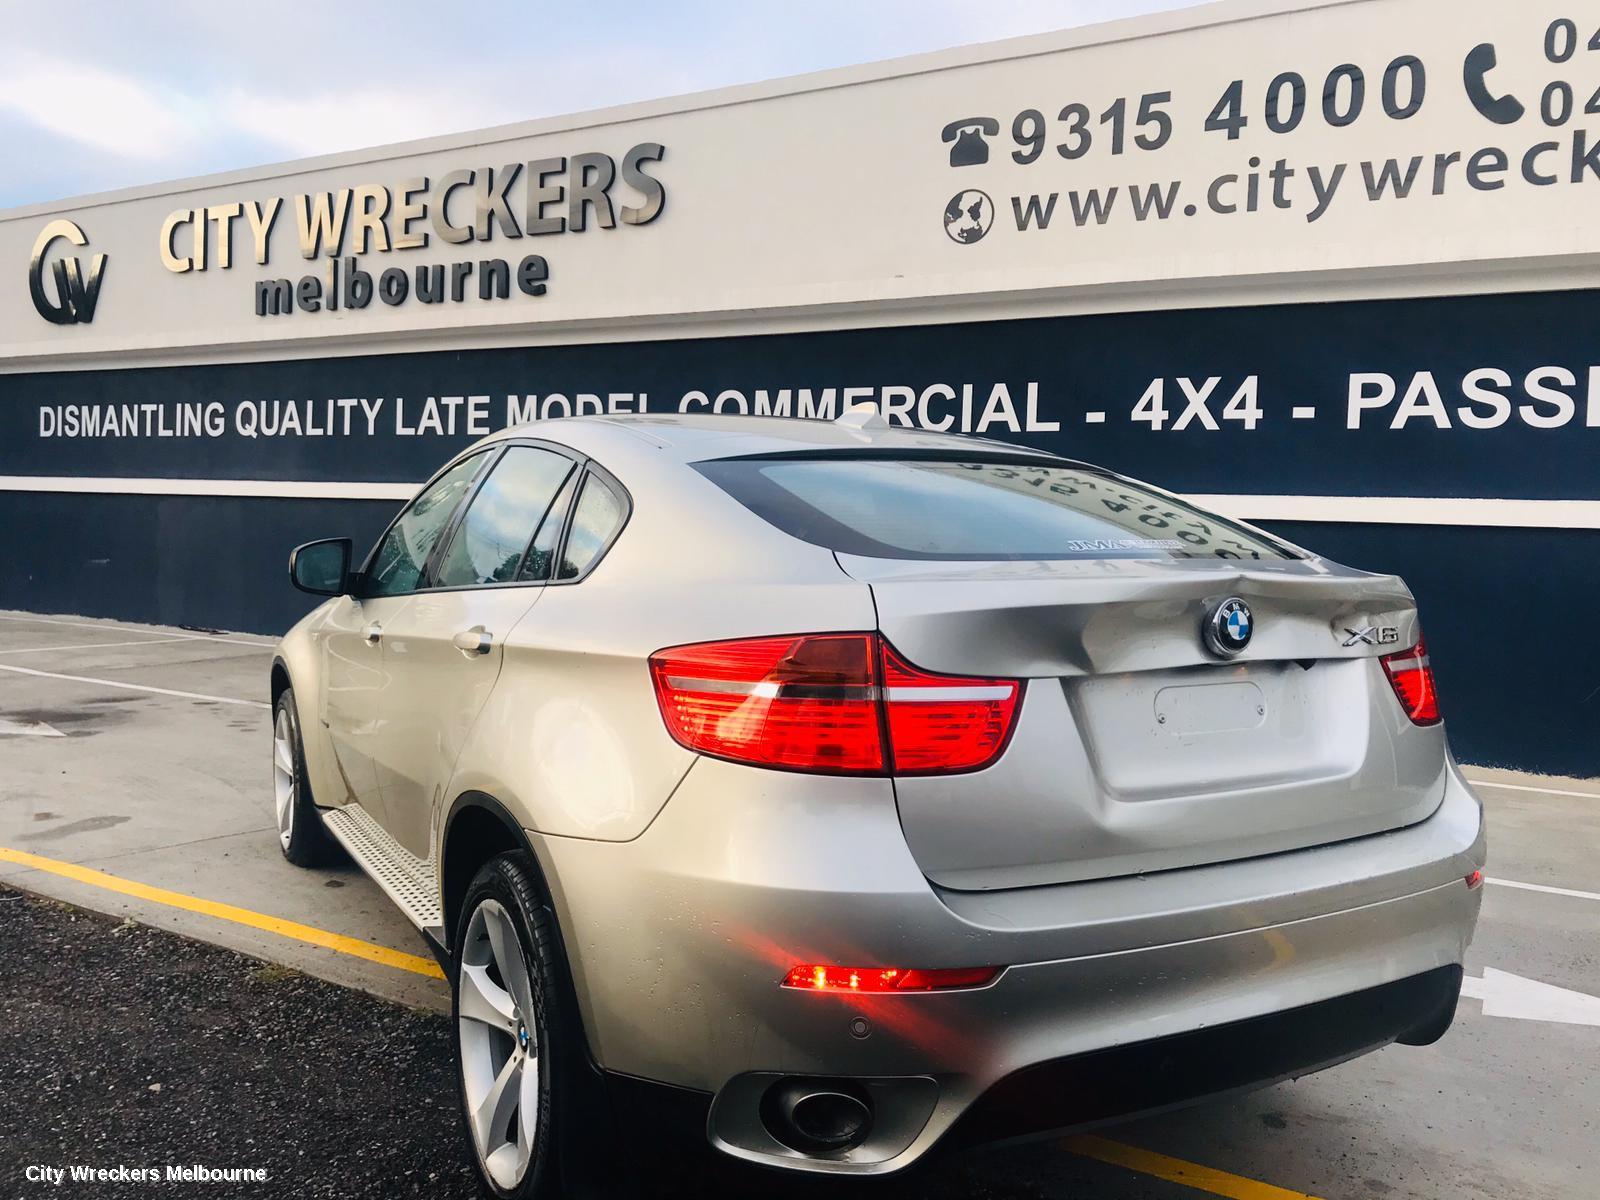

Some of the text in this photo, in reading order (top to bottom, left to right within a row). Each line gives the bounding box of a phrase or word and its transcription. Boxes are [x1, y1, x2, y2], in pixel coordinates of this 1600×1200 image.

[1011, 54, 1426, 165] 9315 4000
[159, 142, 666, 273] CITY WRECKERS
[254, 255, 549, 316] melbourne
[39, 402, 226, 438] DISMANTLING
[235, 397, 384, 438] QUALITY
[394, 395, 490, 435] LATE
[1131, 375, 1264, 431] 4X4
[1347, 365, 1600, 430] PASS
[1223, 602, 1251, 619] BMW
[1342, 626, 1399, 647] X6
